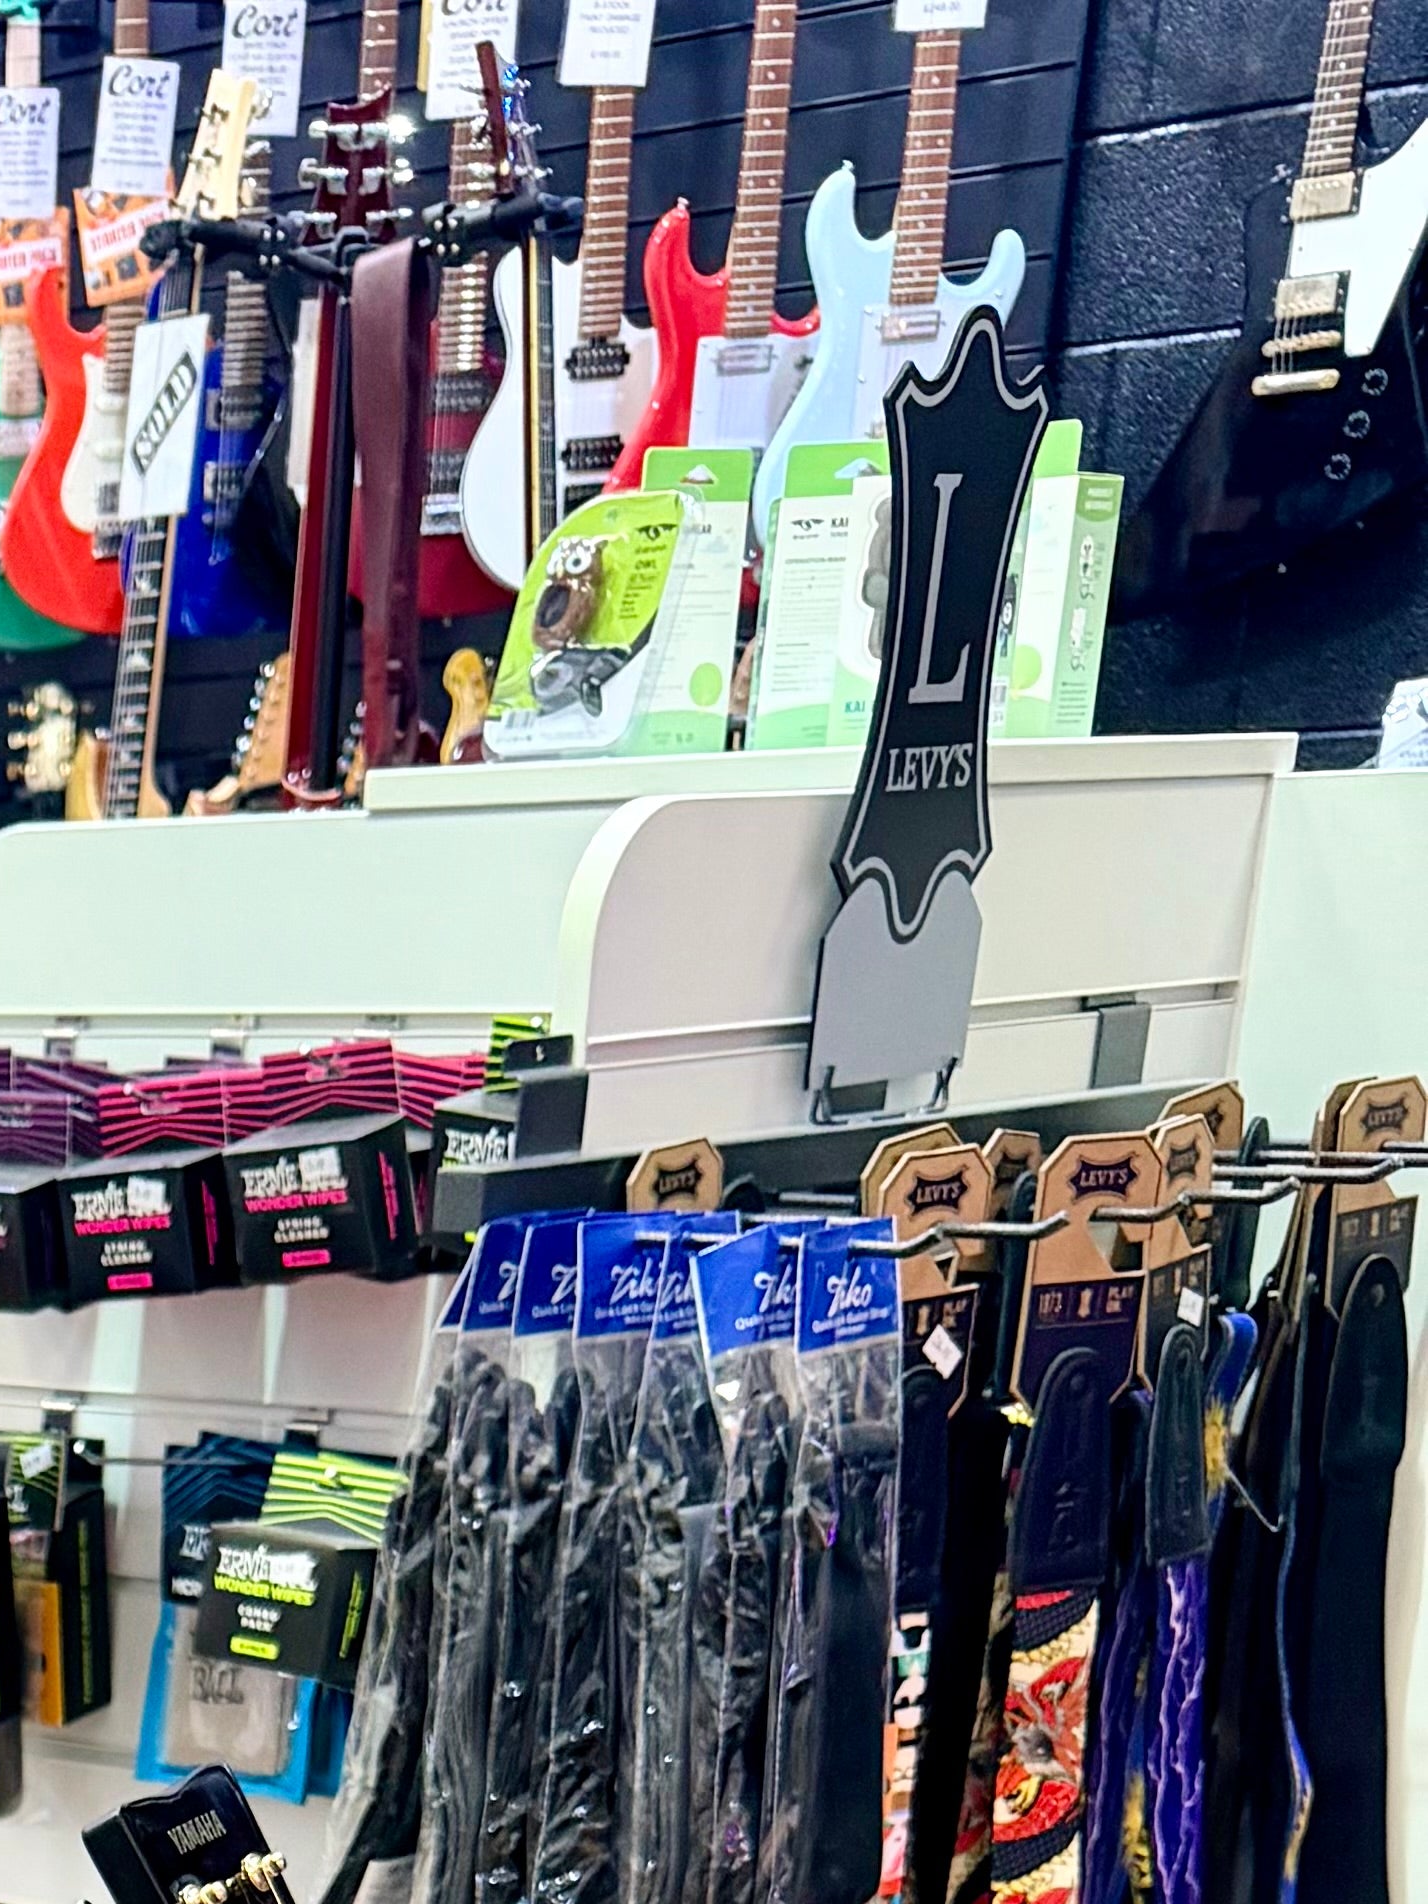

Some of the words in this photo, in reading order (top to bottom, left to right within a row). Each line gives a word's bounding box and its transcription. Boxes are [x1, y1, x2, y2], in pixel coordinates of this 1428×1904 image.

[233, 3, 299, 39] Cort
[107, 64, 171, 99] Cort
[907, 472, 971, 705] L
[885, 742, 974, 794] LEVY'S
[241, 1157, 298, 1199] ERNIE
[916, 1181, 961, 1204] LEVY'S
[1079, 1166, 1129, 1187] LEVY'S
[71, 1180, 127, 1221] ERNIE
[245, 1193, 303, 1214] WONDER
[304, 1188, 348, 1206] WIPES
[75, 1218, 130, 1238] WONDER
[131, 1214, 171, 1231] WIPES
[214, 1574, 270, 1600] WONDER
[271, 1583, 316, 1607] WIPES
[166, 1808, 228, 1856] YAMAHA
